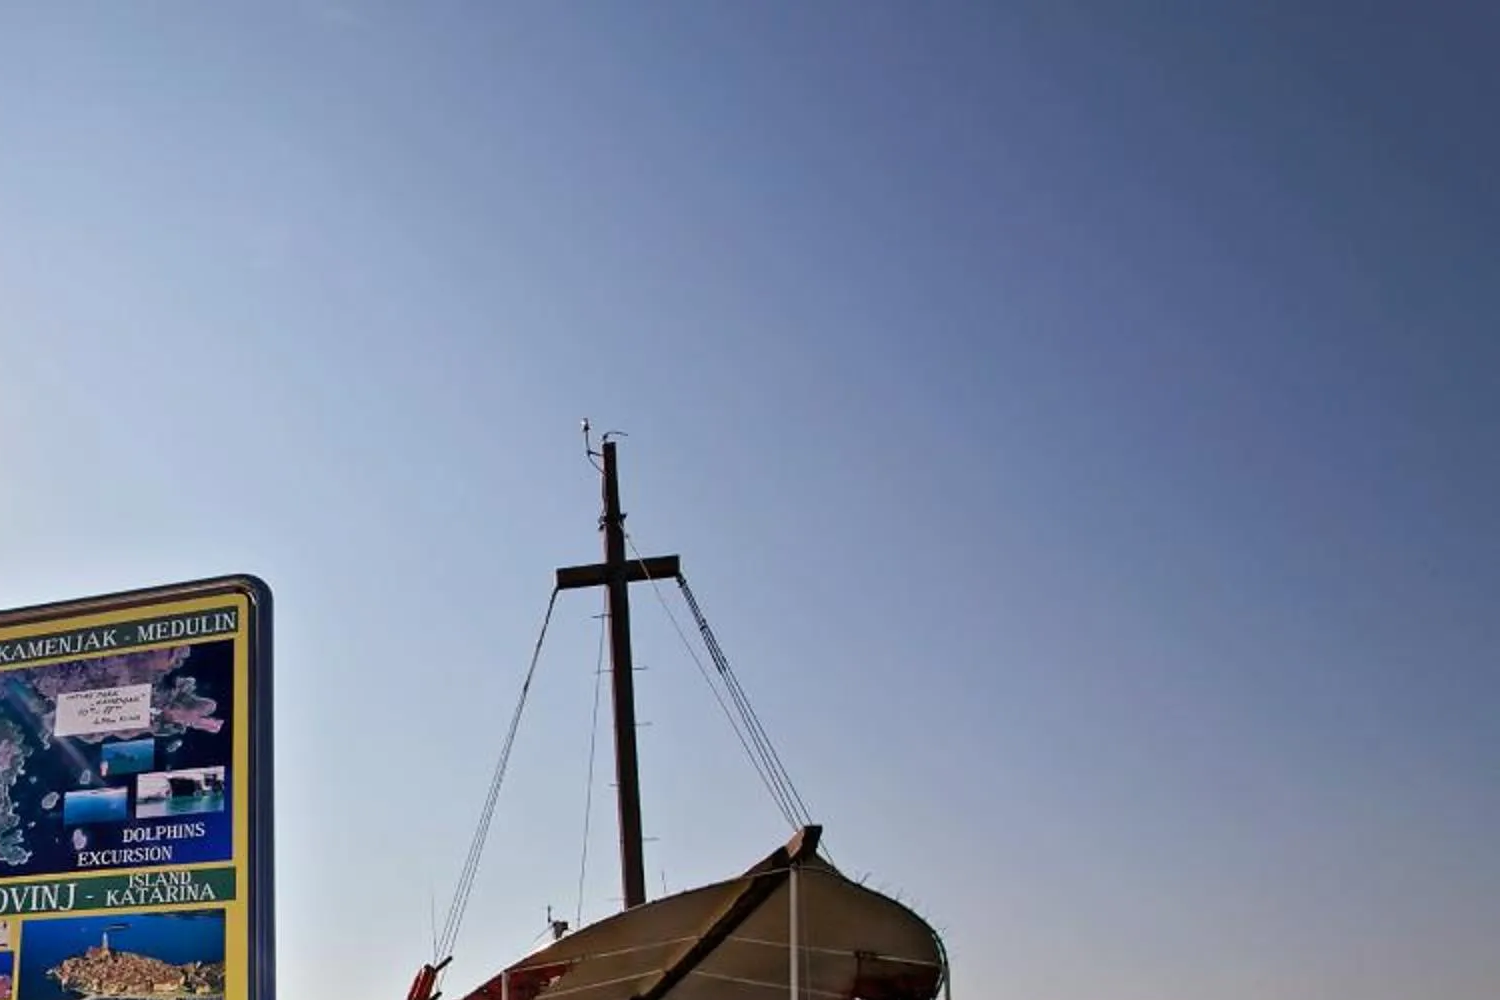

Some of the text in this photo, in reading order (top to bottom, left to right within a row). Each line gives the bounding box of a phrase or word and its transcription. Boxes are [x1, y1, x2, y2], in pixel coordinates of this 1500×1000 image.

[136, 610, 237, 643] MEDULIN
[122, 822, 206, 844] DOLPHINS
[77, 845, 174, 867] EXCURSION
[129, 871, 192, 889] ISLAND
[105, 883, 217, 907] KATARINA
